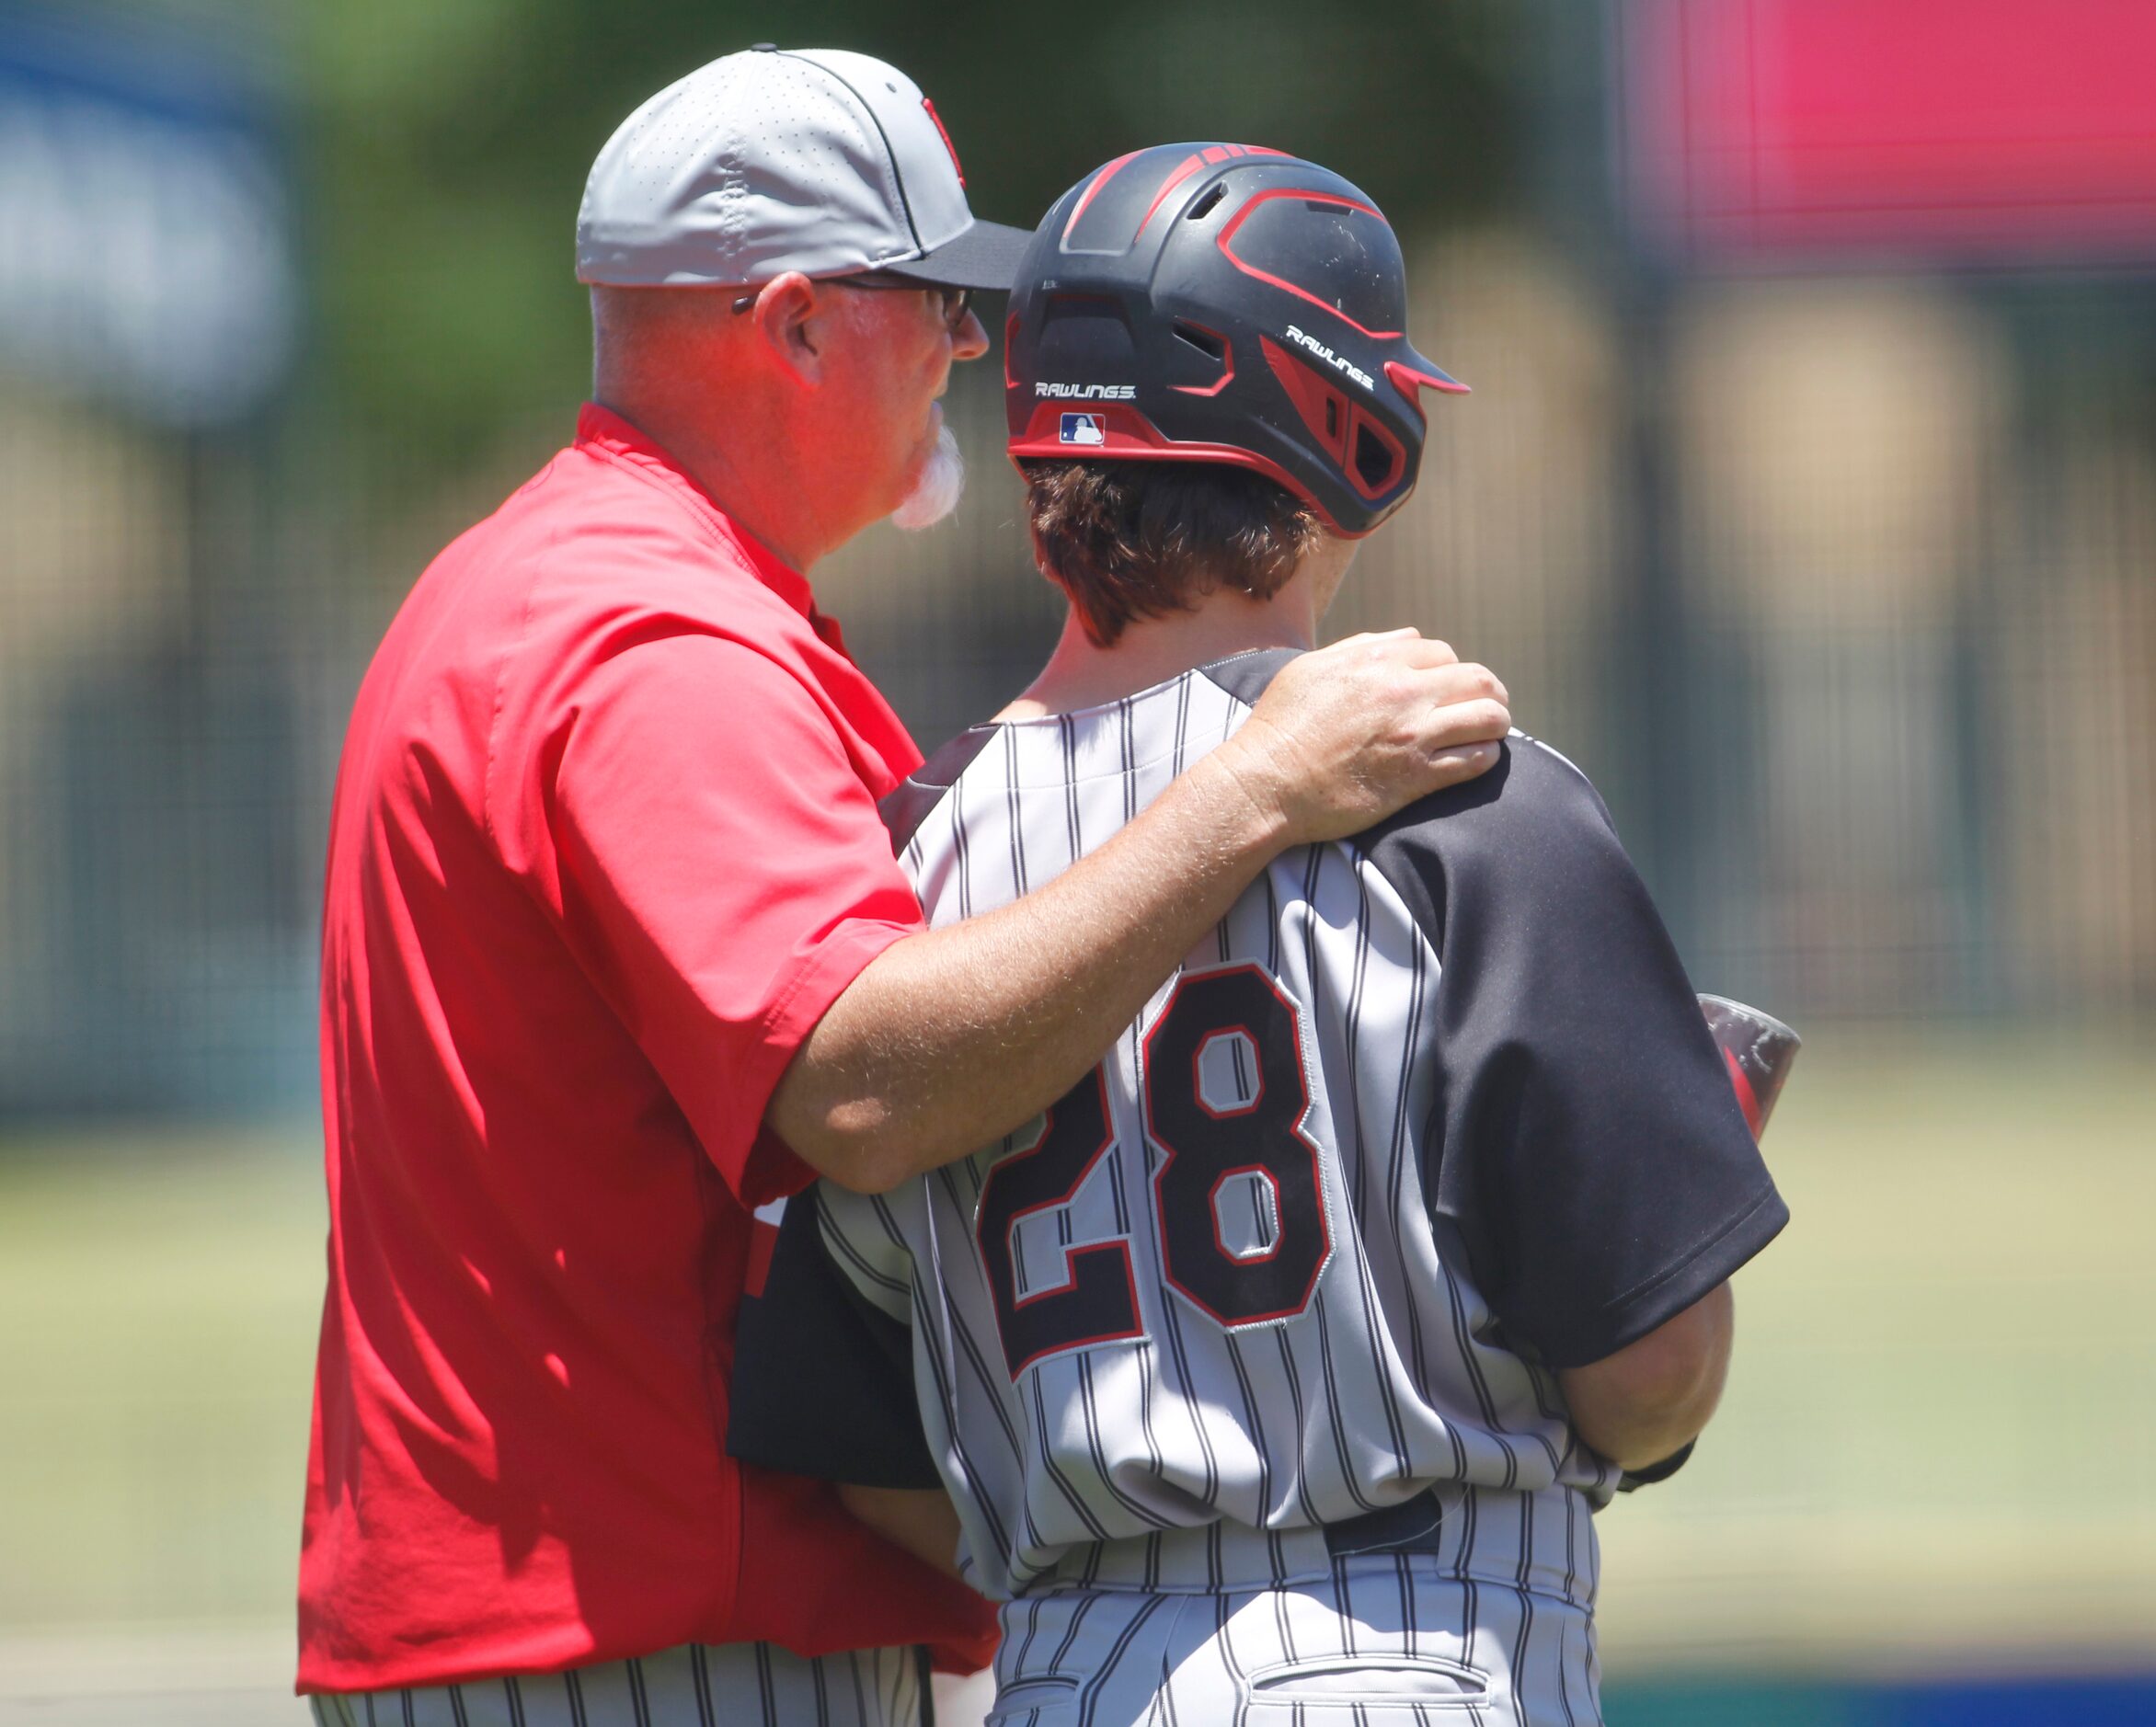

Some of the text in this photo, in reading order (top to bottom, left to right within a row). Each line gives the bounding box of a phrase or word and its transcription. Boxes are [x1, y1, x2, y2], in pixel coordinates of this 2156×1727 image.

[1035, 382, 1136, 399] RAWLINGS
[1286, 325, 1374, 391] RAWLINGS
[973, 957, 1336, 1386] 28
